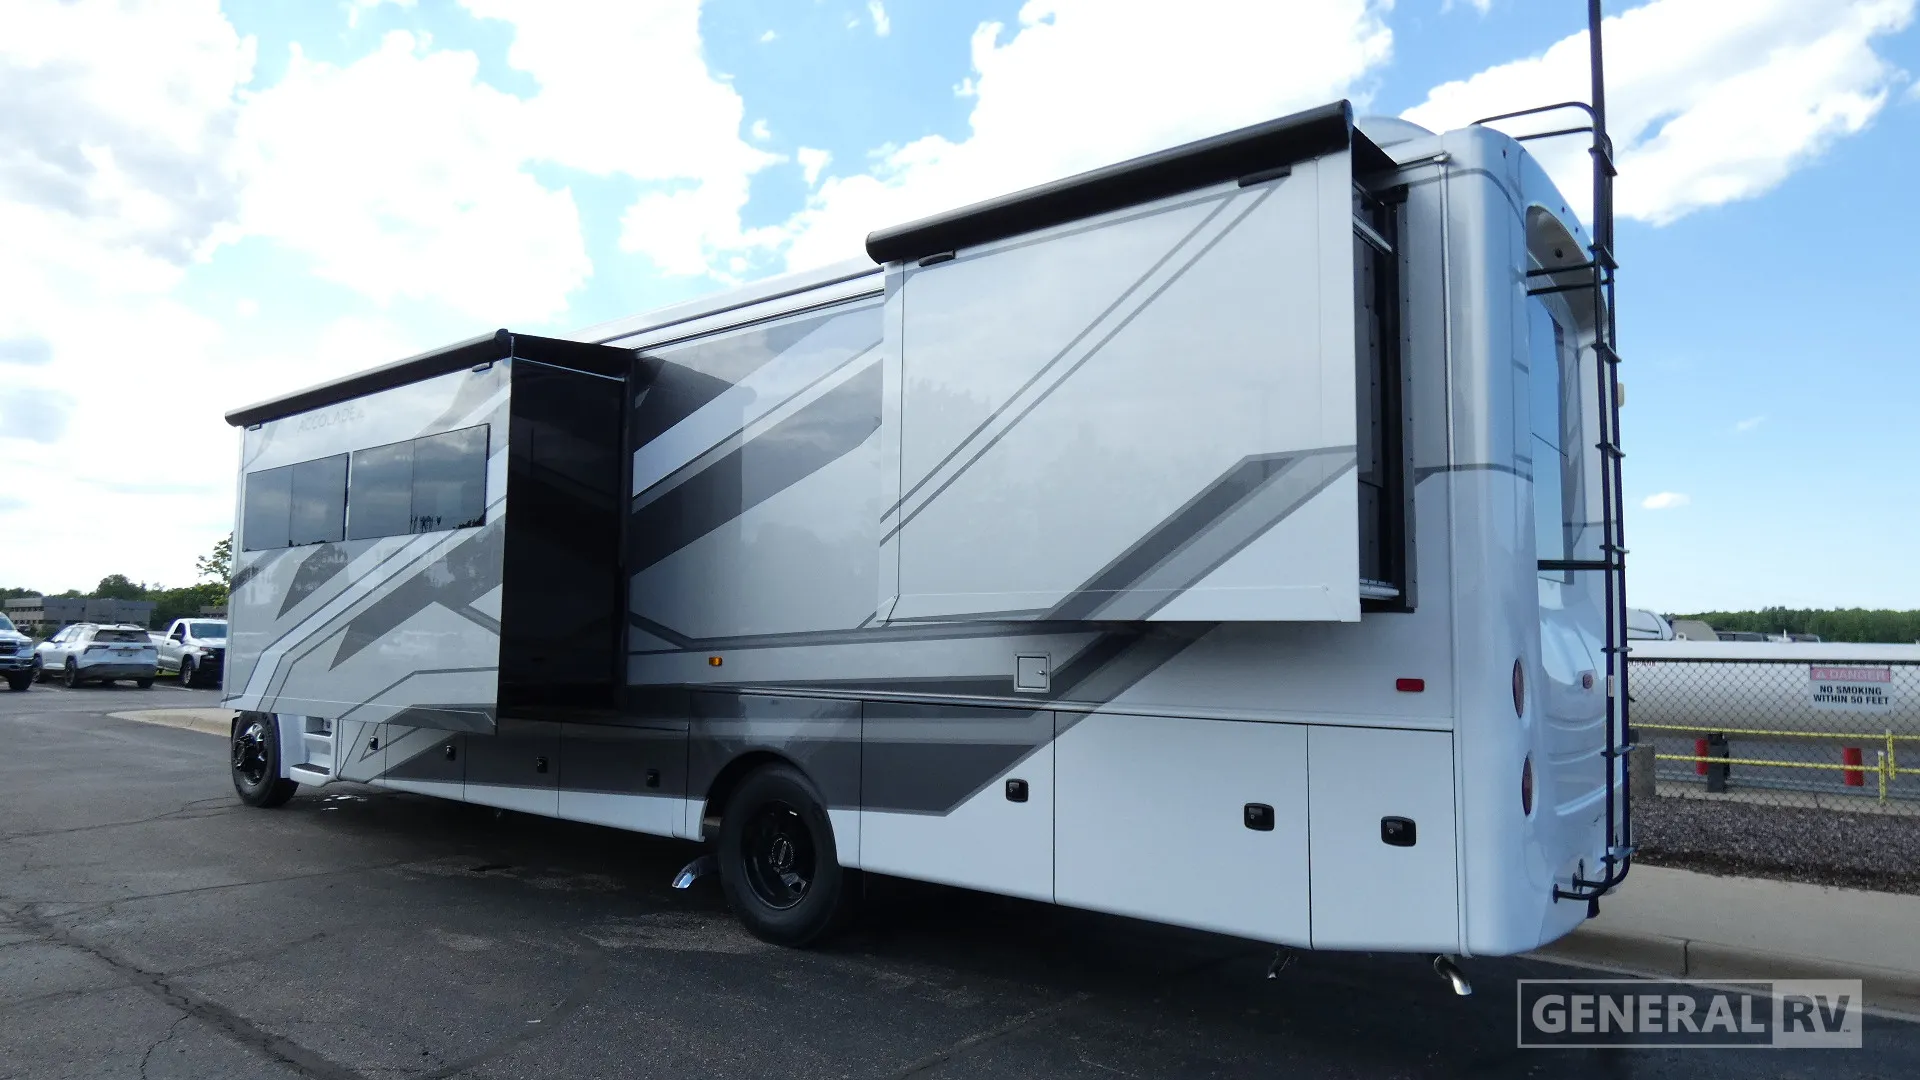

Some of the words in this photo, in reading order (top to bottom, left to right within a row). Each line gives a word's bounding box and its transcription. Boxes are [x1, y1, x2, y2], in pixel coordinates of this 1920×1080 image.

[1829, 669, 1886, 681] DANGER
[1819, 685, 1833, 693] NO
[1836, 686, 1882, 695] SMOKING
[1813, 694, 1848, 703] WITHIN
[1850, 696, 1863, 704] 50
[1866, 697, 1889, 705] FEET
